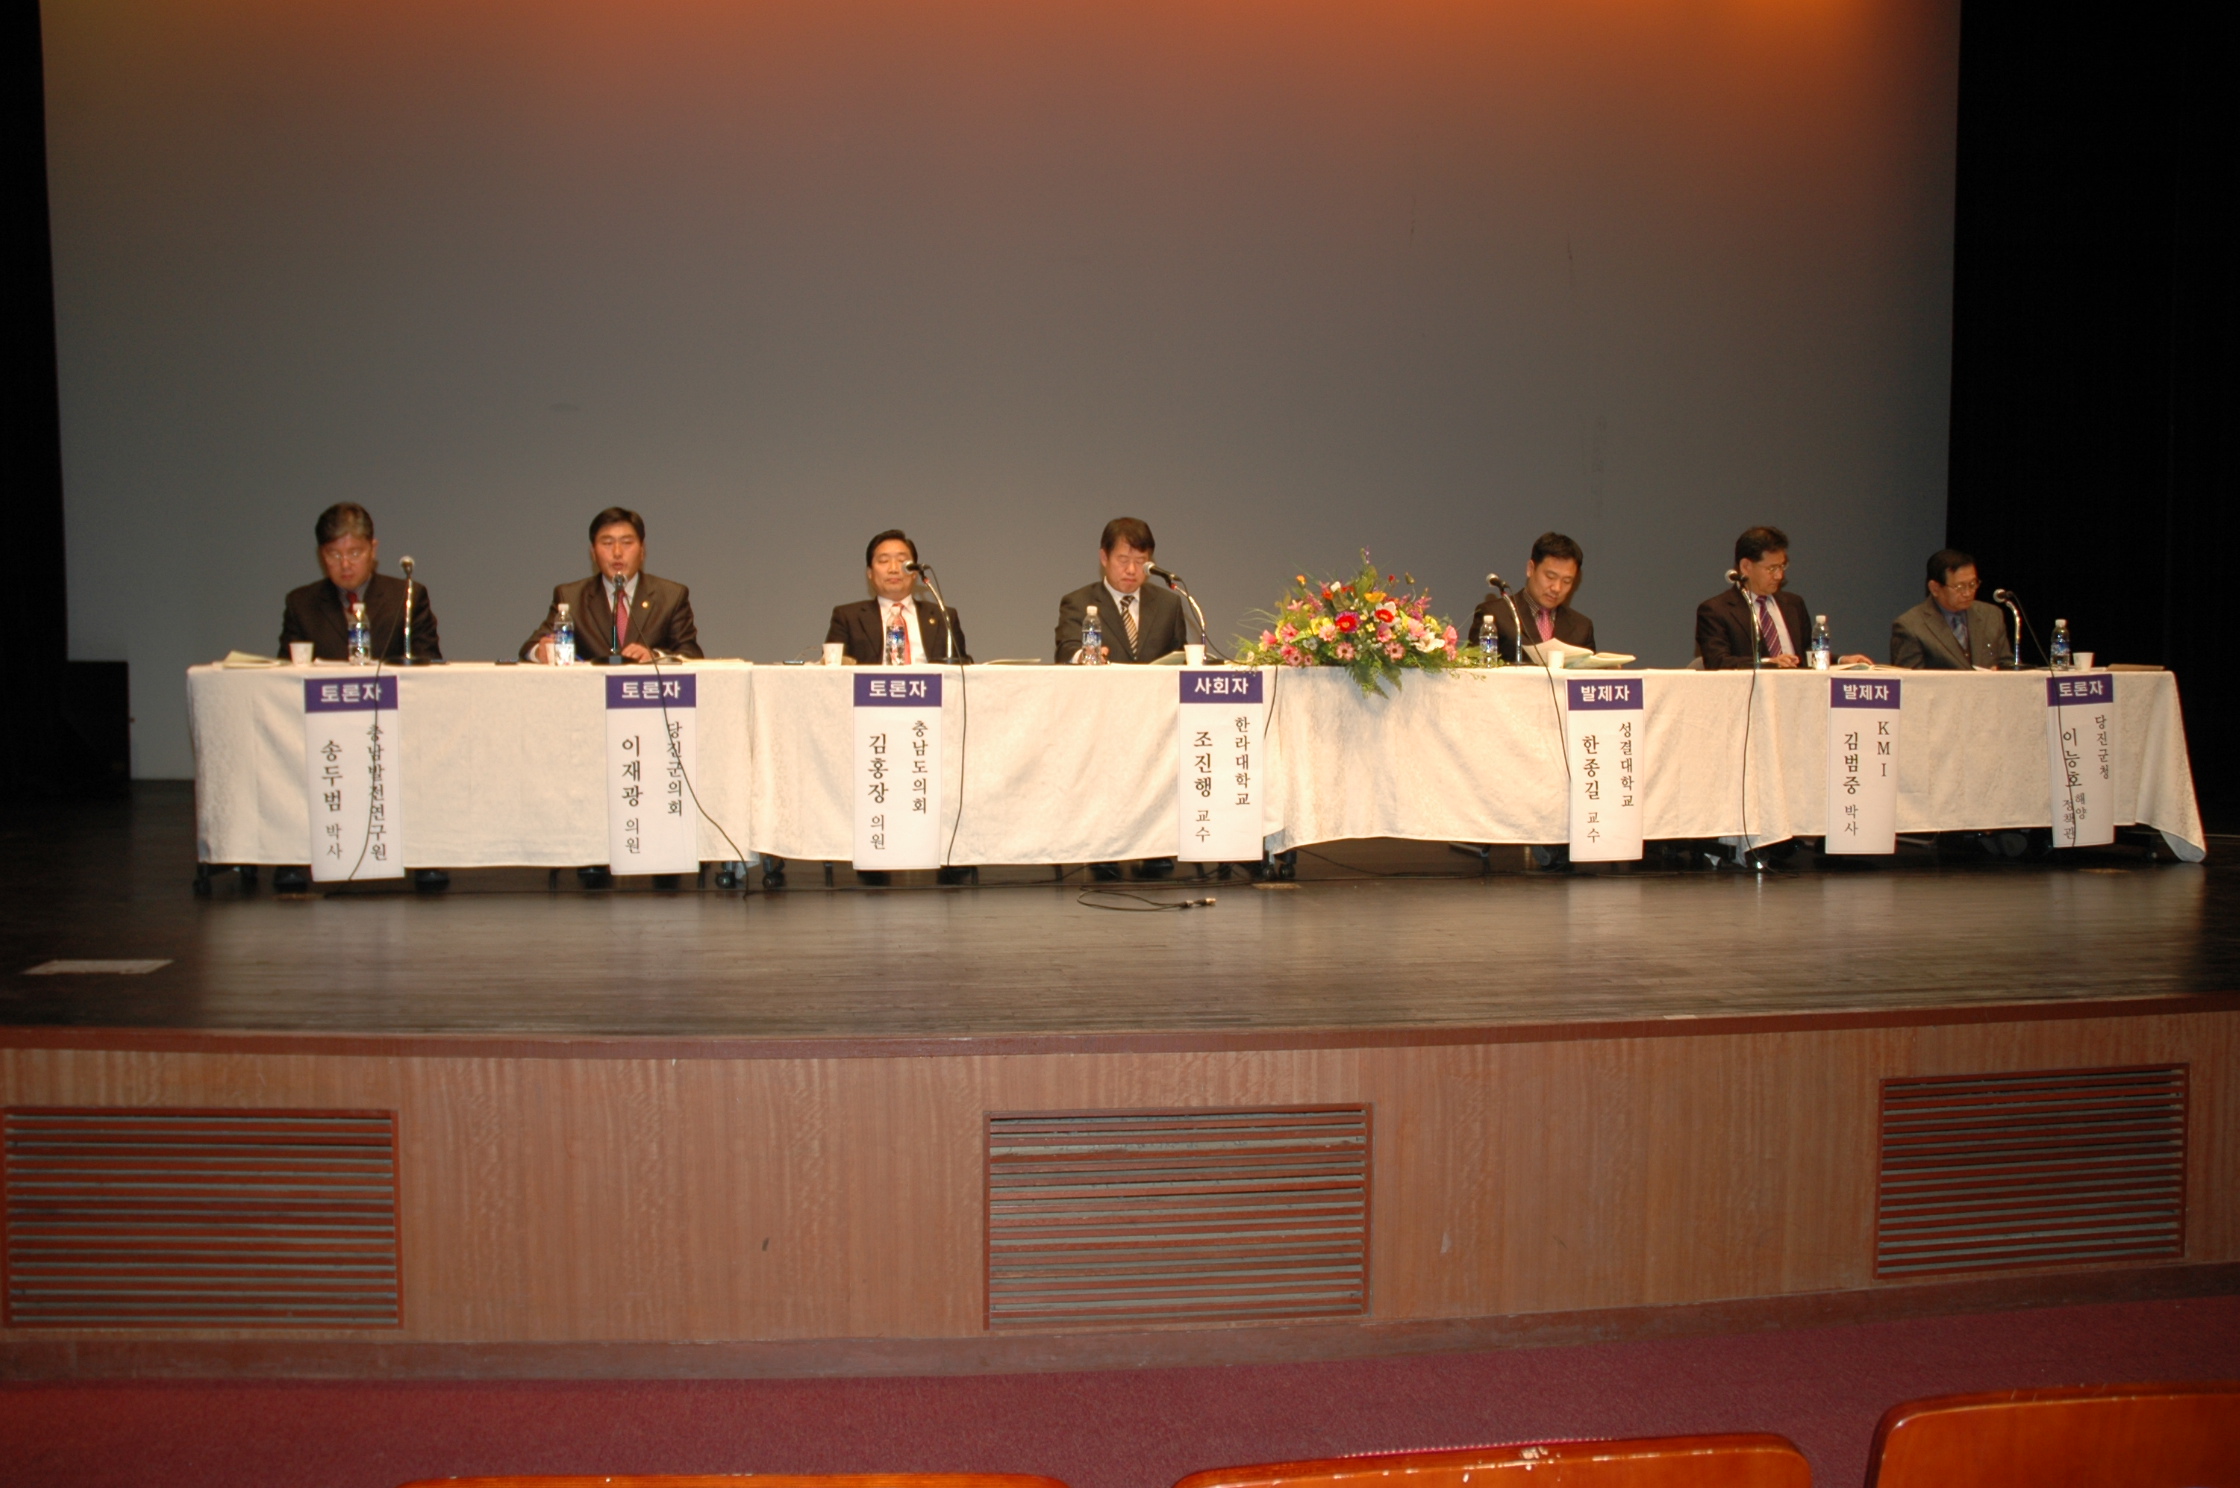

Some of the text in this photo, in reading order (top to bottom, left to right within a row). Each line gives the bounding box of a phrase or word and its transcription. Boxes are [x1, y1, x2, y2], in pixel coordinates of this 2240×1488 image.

[320, 683, 382, 702] 토론자
[621, 681, 681, 699] 토론자
[869, 681, 927, 698] 토론자
[1194, 677, 1249, 696] 사회자
[1581, 685, 1630, 702] 발제자
[1843, 684, 1889, 701] 발제자
[2059, 681, 2103, 697] 토론자
[667, 721, 683, 817] 당진군의회
[911, 721, 928, 815] 충남도의회
[1235, 717, 1251, 807] 한라대학교
[1619, 722, 1634, 807] 성결대학교
[1843, 732, 1860, 836] 김범중 박사
[2063, 728, 2082, 787] 이능호
[2095, 715, 2109, 780] 당진군청
[320, 740, 342, 858] 송두범 박사
[621, 736, 642, 855] 이재광 의원
[868, 734, 889, 851] 김홍장 의원
[1193, 731, 1214, 843] 조진행 교수
[1582, 736, 1600, 844] 한종길 교수
[2075, 793, 2087, 819] 해양
